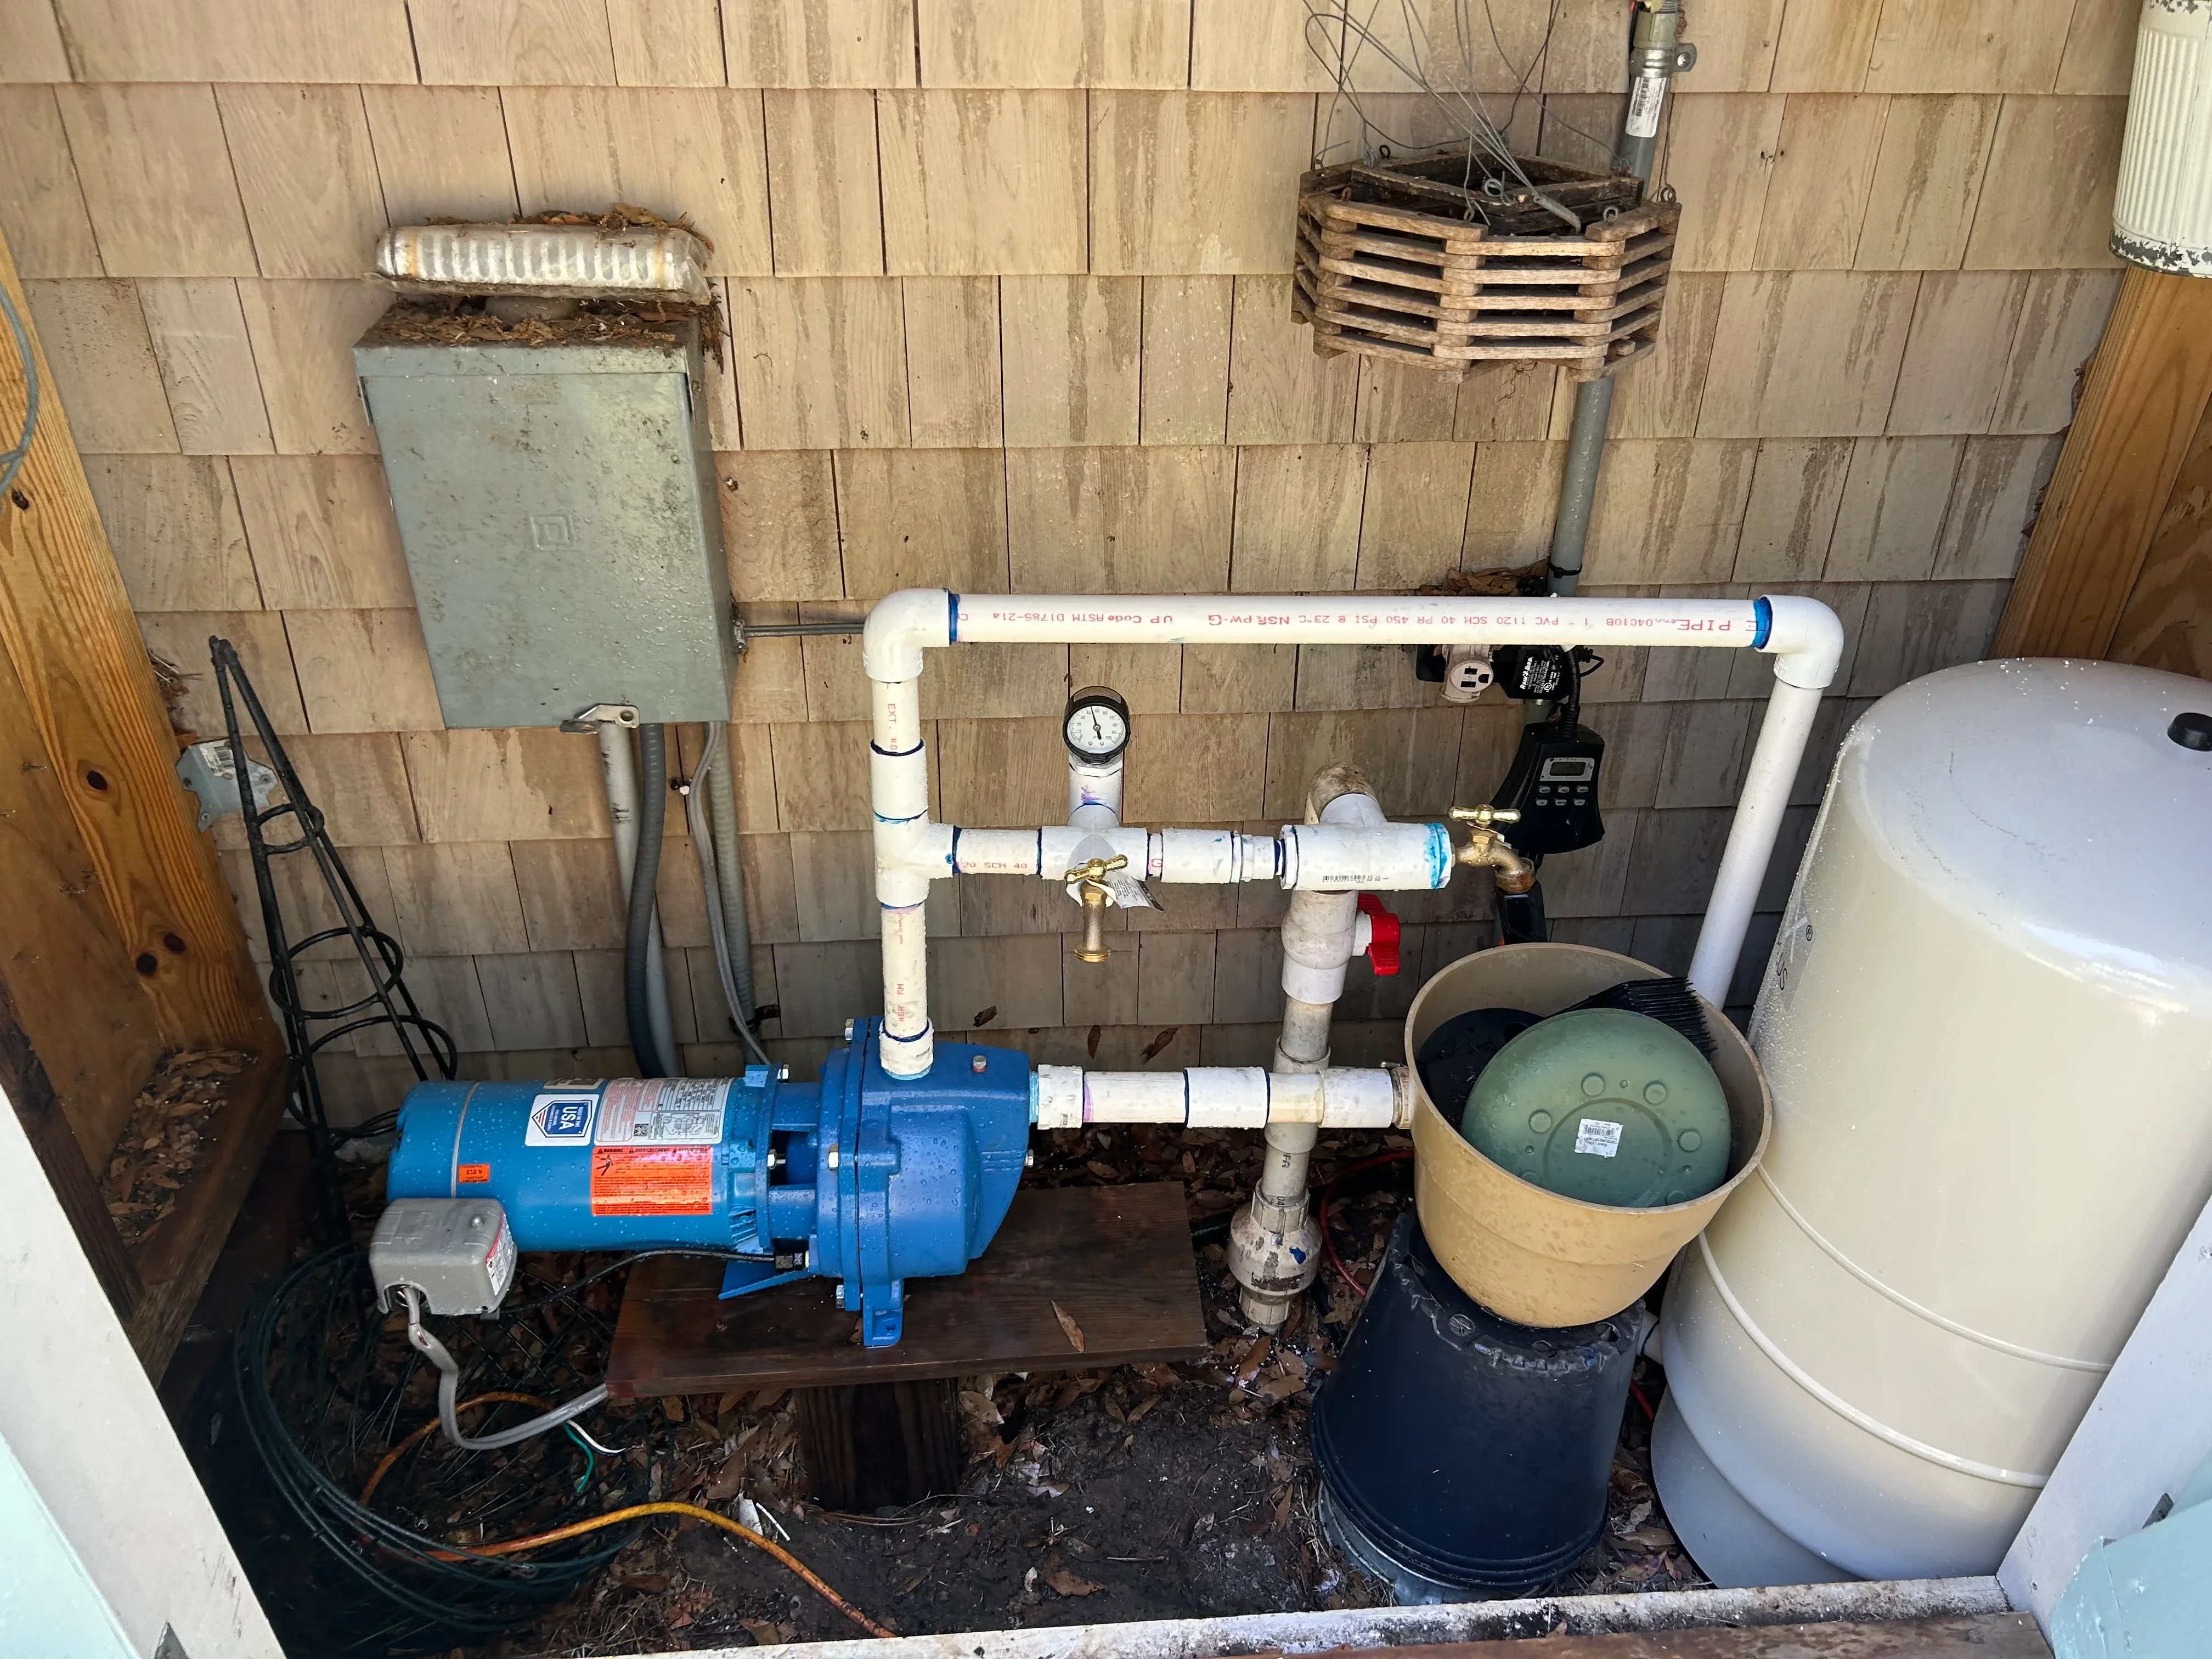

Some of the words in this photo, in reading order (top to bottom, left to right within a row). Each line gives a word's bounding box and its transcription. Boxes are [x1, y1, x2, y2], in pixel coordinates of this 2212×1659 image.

[992, 613, 1064, 622] D1785-21a
[1108, 615, 1142, 624] Code
[1355, 616, 1378, 624] PSI
[1385, 616, 1408, 624] 450
[1417, 616, 1432, 624] PR
[1441, 616, 1457, 624] 40
[1464, 616, 1488, 624] SCH
[558, 1106, 578, 1130] USA
